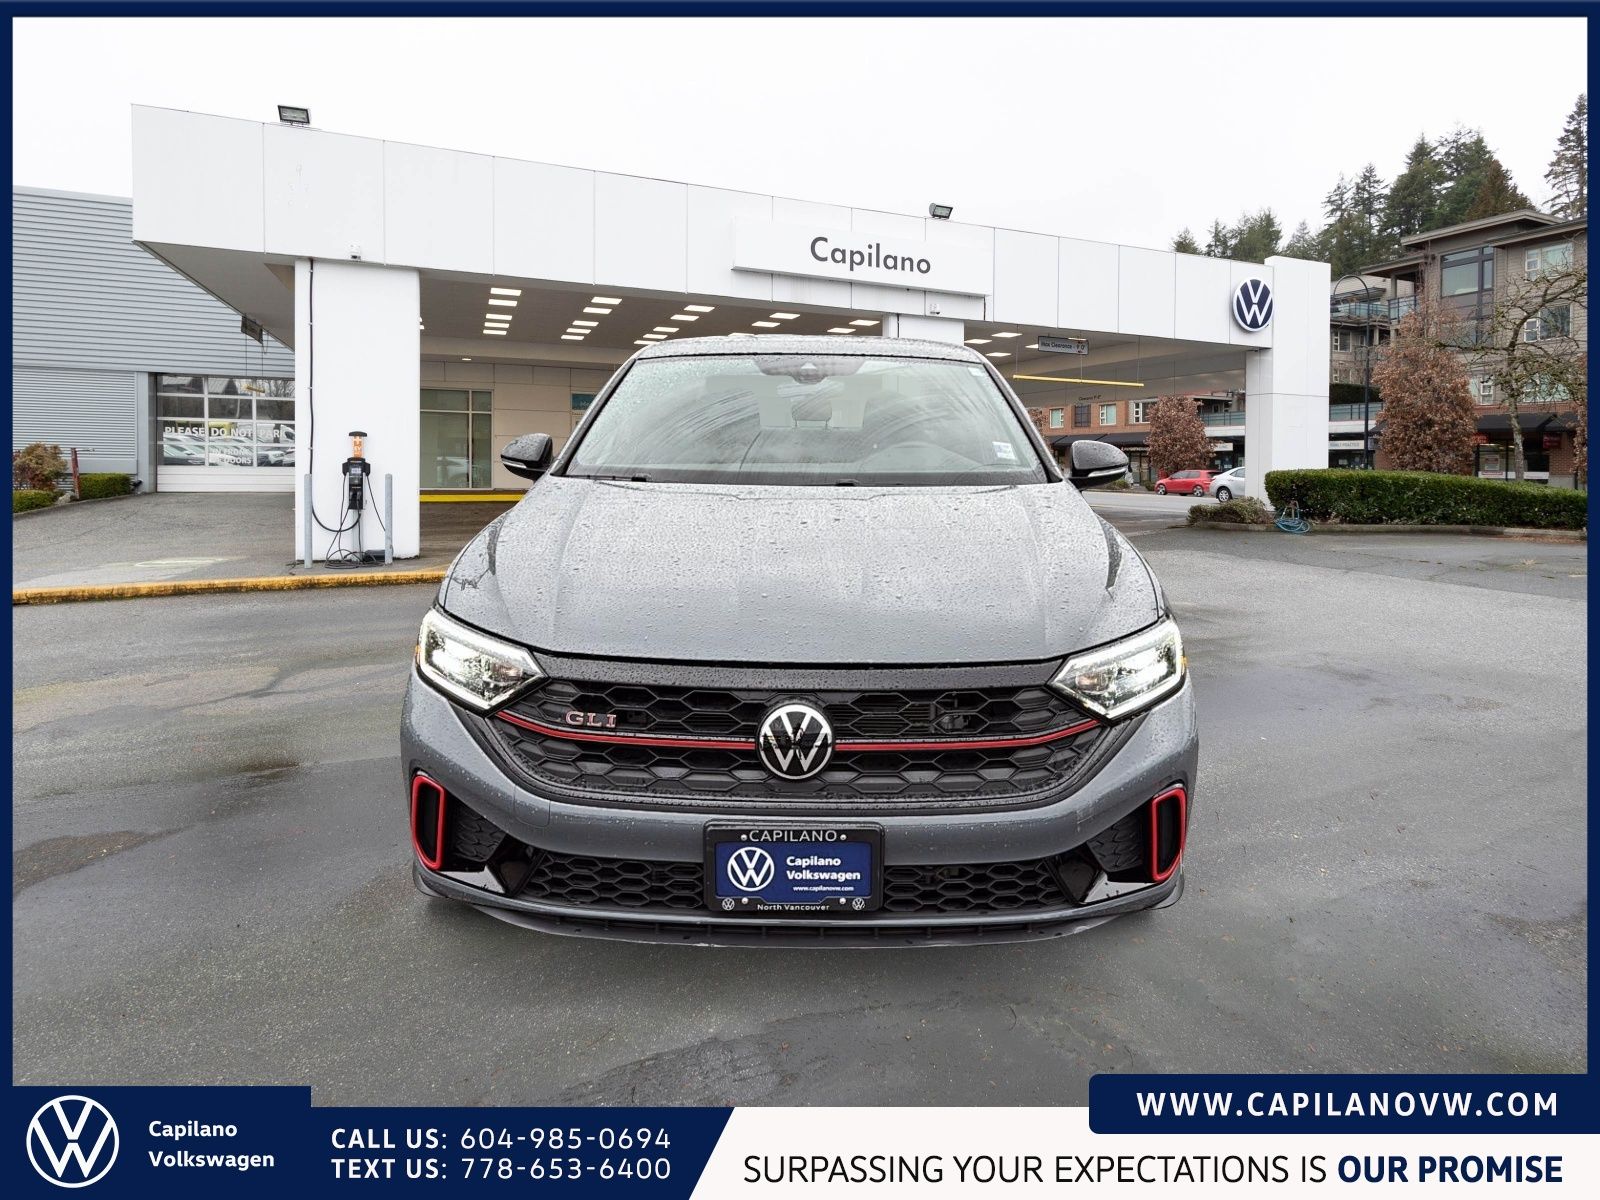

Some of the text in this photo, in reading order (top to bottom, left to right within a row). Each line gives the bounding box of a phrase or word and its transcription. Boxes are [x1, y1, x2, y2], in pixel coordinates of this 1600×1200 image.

[810, 236, 931, 274] Capilano
[164, 426, 205, 437] PLEASE
[211, 427, 227, 436] DO
[230, 428, 253, 437] NOT
[565, 710, 617, 729] GLI
[749, 830, 837, 842] CAPILANO
[786, 856, 841, 868] Capilano
[786, 869, 861, 883] Volkswagen
[792, 884, 855, 892] www.capilanovw.com
[757, 903, 830, 911] North Vancouver
